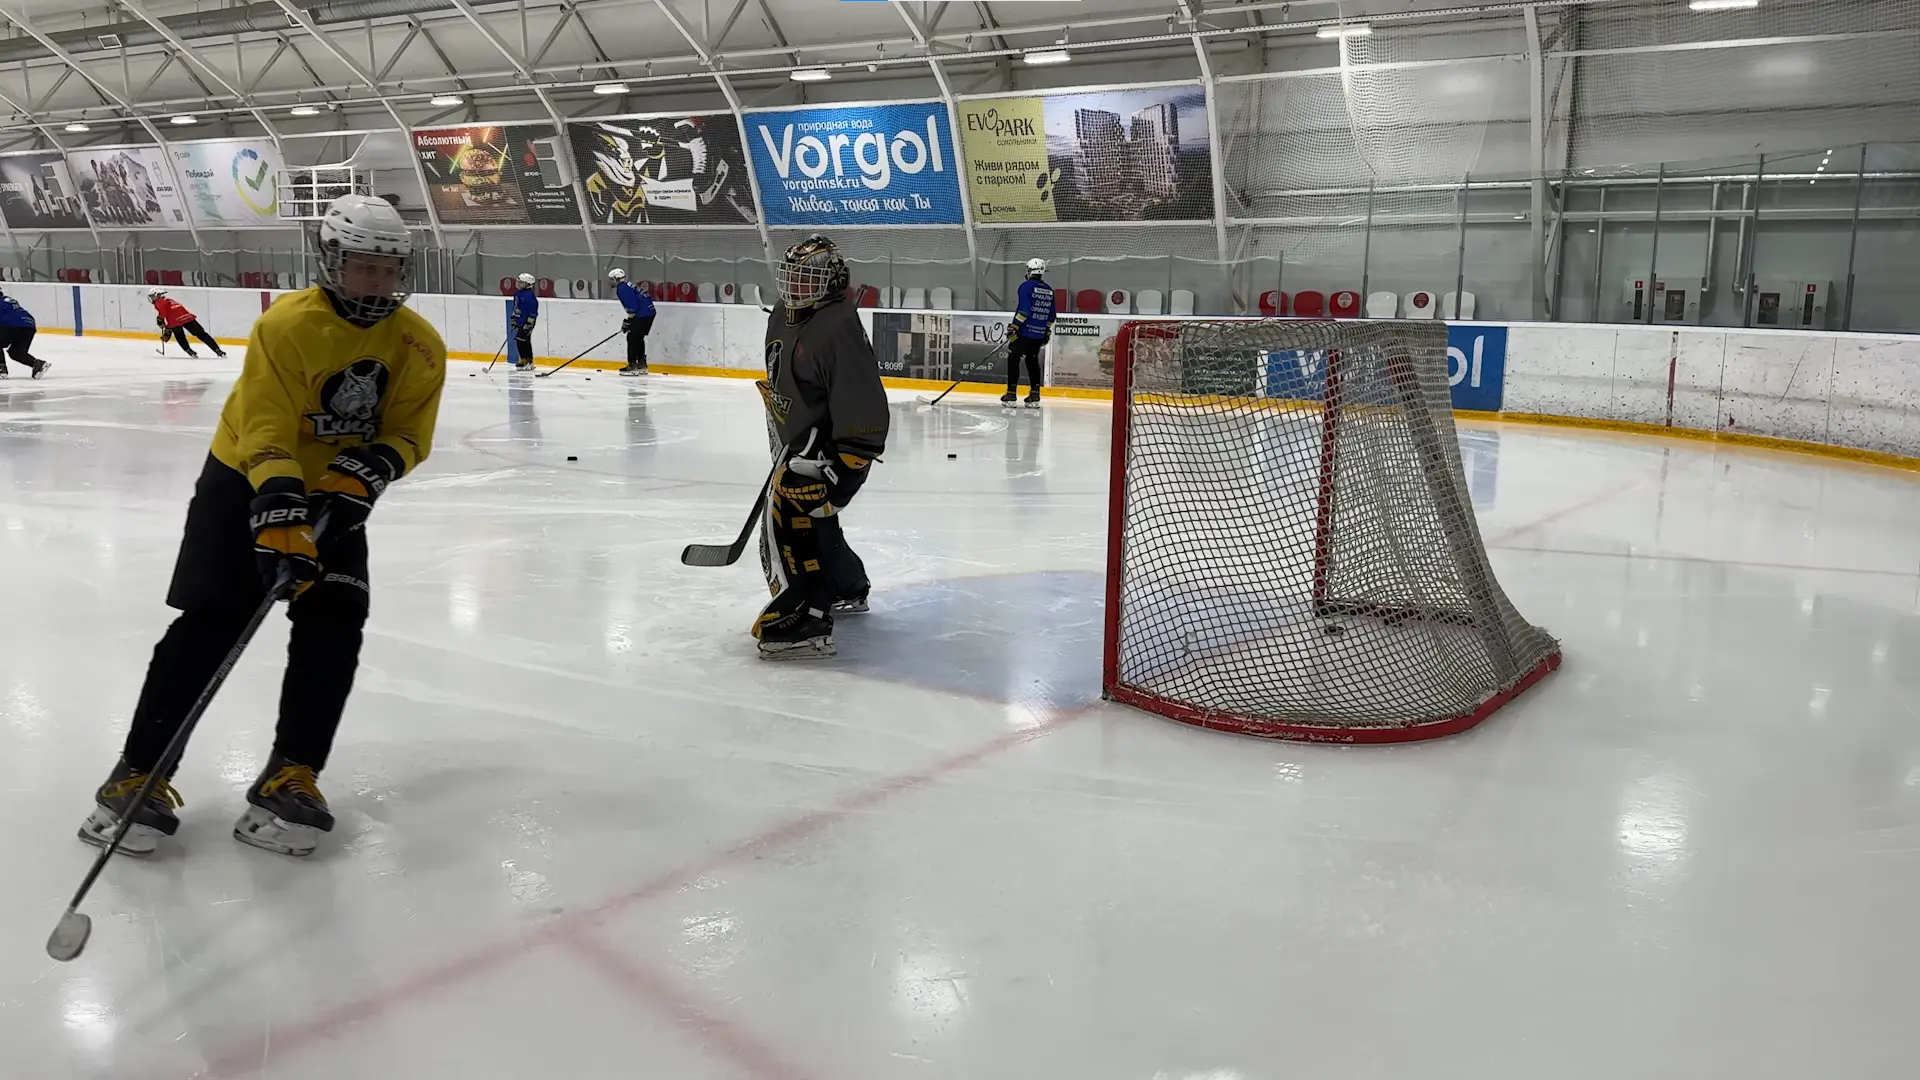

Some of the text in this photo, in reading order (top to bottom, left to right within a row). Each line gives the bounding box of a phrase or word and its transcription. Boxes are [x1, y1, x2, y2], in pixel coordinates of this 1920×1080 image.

[798, 119, 873, 133] природная вода
[967, 108, 1035, 137] EVOPARK
[417, 132, 472, 146] Абсолютный
[758, 114, 944, 190] Vorgol
[973, 159, 1040, 173] Живи рядом
[782, 176, 861, 193] vorgolmsk.ru
[984, 172, 1027, 187] парком!
[788, 193, 931, 213] Живая, такая как Ты
[973, 322, 1004, 343] EVO
[884, 361, 903, 371] 8099
[329, 454, 385, 495] BAUE
[249, 507, 309, 530] UER
[323, 572, 370, 593] BAUE
